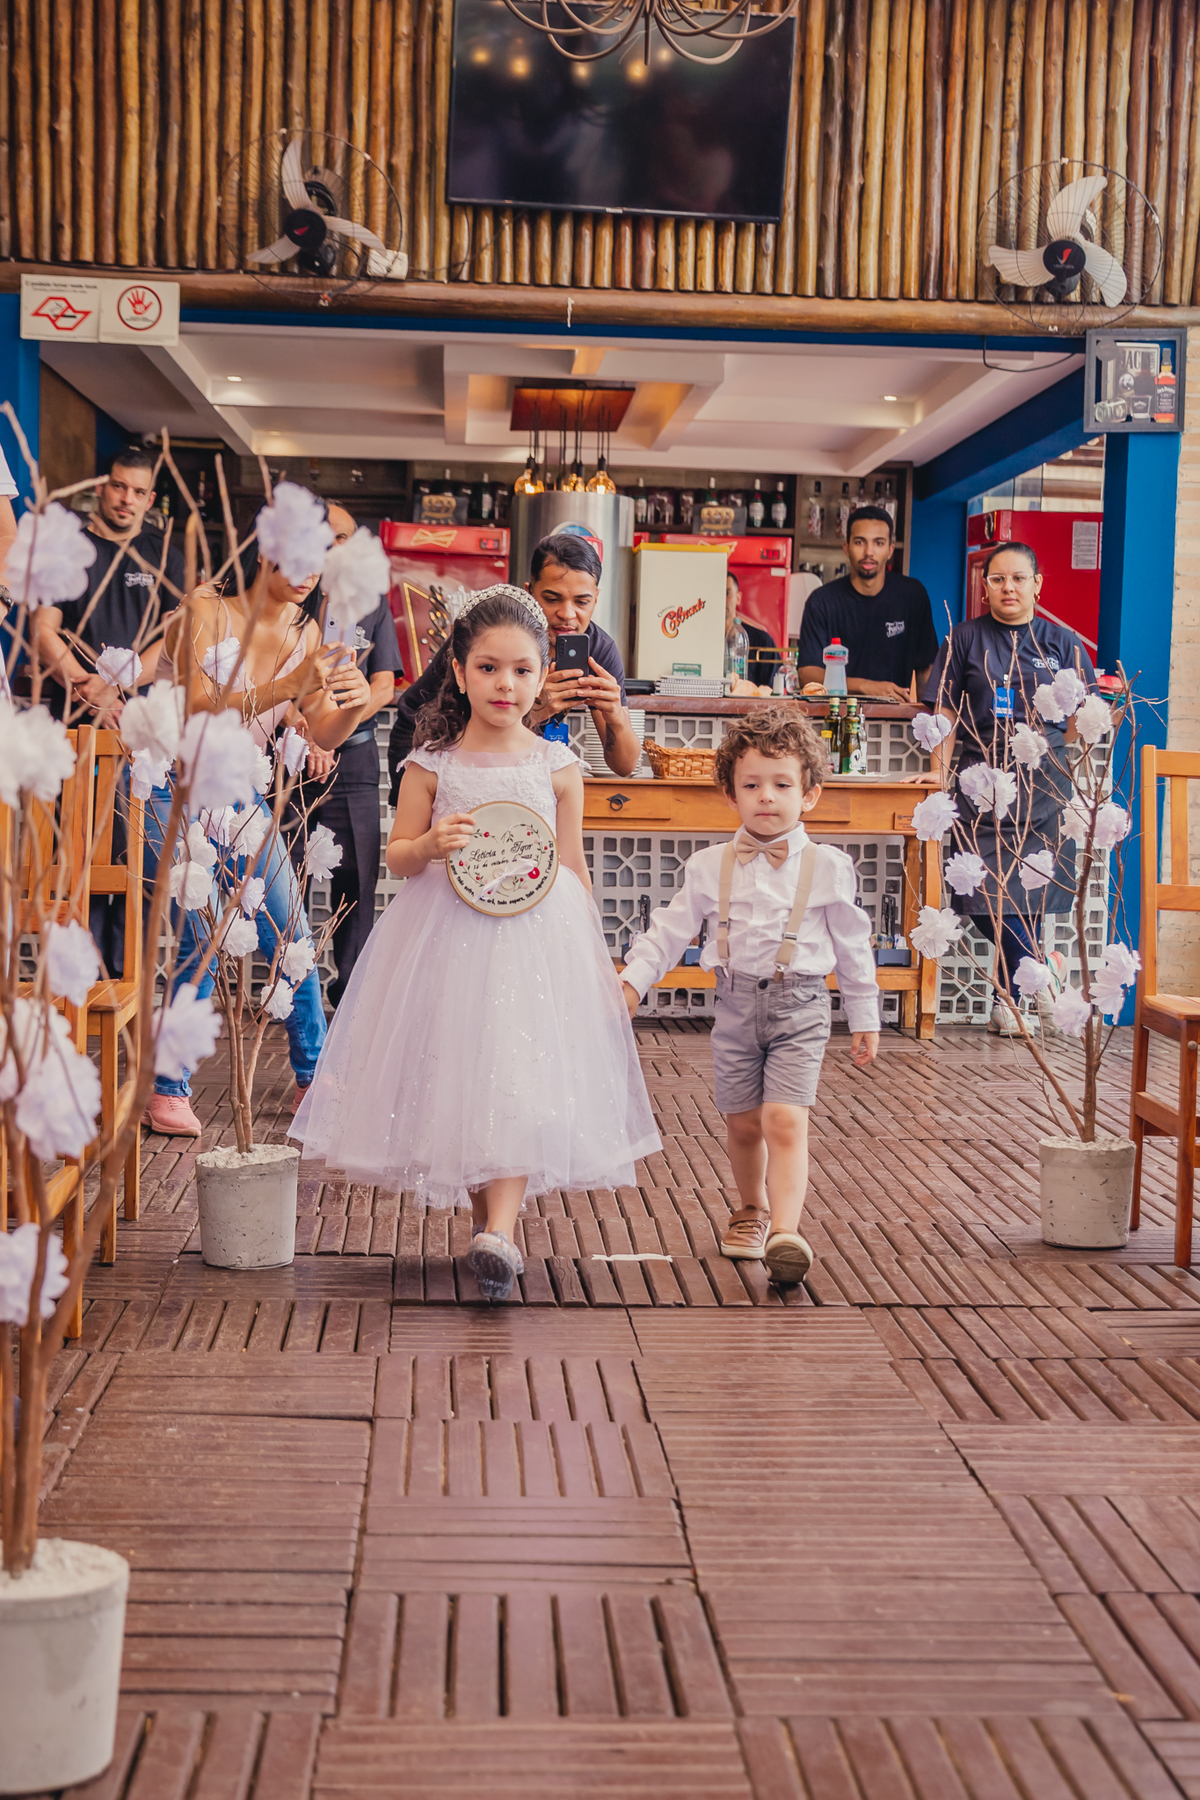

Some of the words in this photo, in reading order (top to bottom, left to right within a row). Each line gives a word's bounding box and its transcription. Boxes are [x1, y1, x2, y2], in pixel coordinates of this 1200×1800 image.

[1120, 350, 1142, 369] JAC
[661, 597, 707, 639] Colorado
[510, 840, 533, 855] Igor
